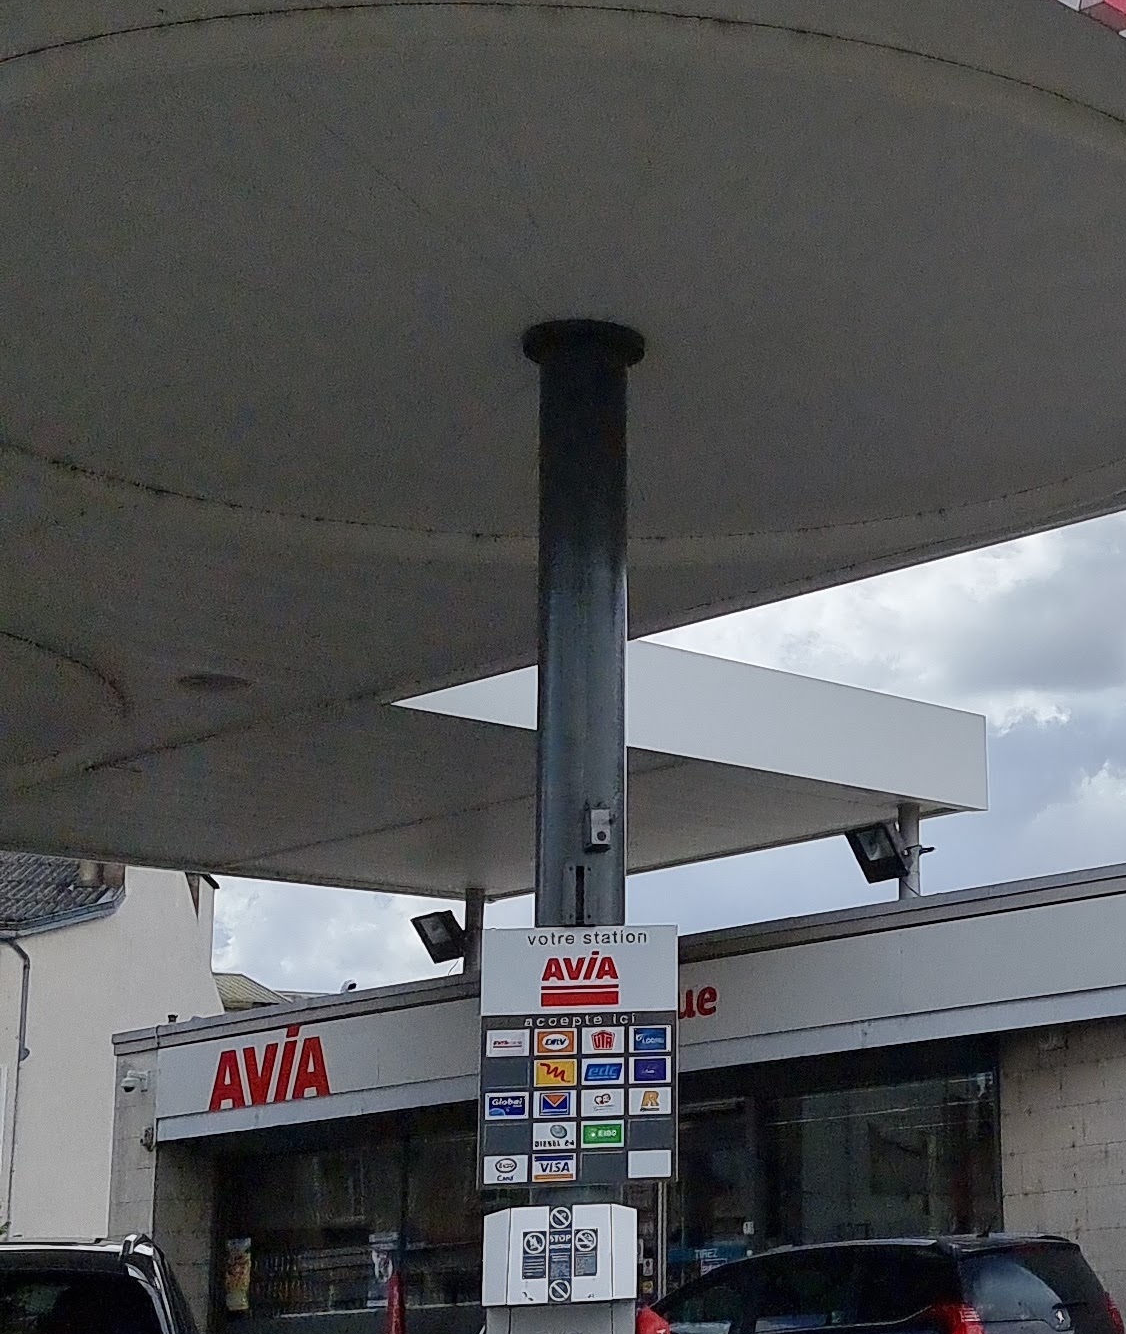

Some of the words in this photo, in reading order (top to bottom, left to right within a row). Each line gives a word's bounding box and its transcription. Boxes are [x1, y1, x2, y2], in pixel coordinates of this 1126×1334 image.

[527, 933, 576, 946] votre
[582, 929, 648, 945] station
[542, 951, 619, 981] AVIA
[208, 1022, 332, 1113] AVIA
[539, 1161, 571, 1174] VISA
[549, 1234, 572, 1243] STOP
